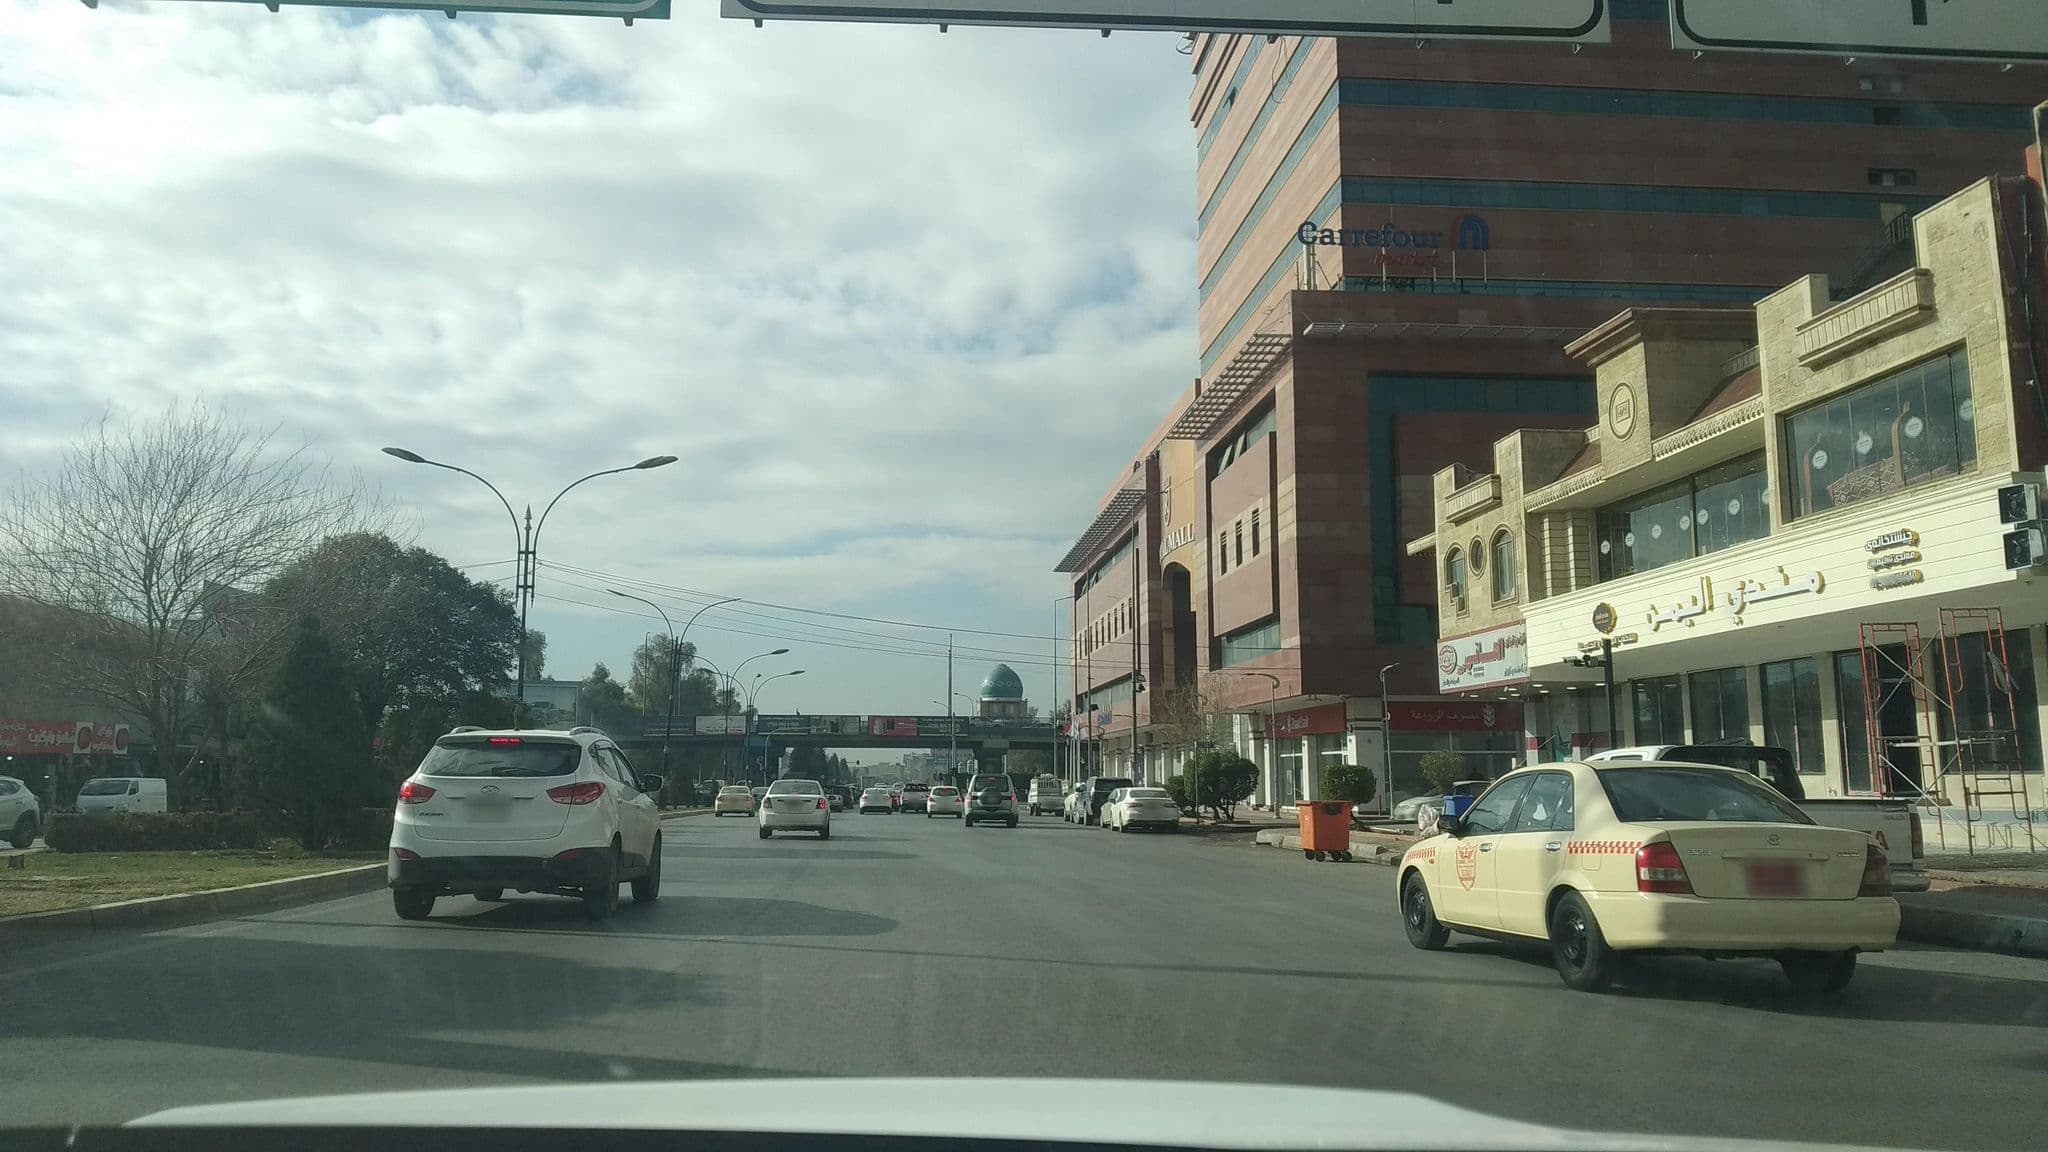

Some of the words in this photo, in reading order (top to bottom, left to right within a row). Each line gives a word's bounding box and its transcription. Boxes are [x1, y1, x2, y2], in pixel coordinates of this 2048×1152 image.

[1298, 221, 1443, 248] Carrefour
[1168, 523, 1195, 553] MALL
[1646, 575, 1714, 632] اليمن
